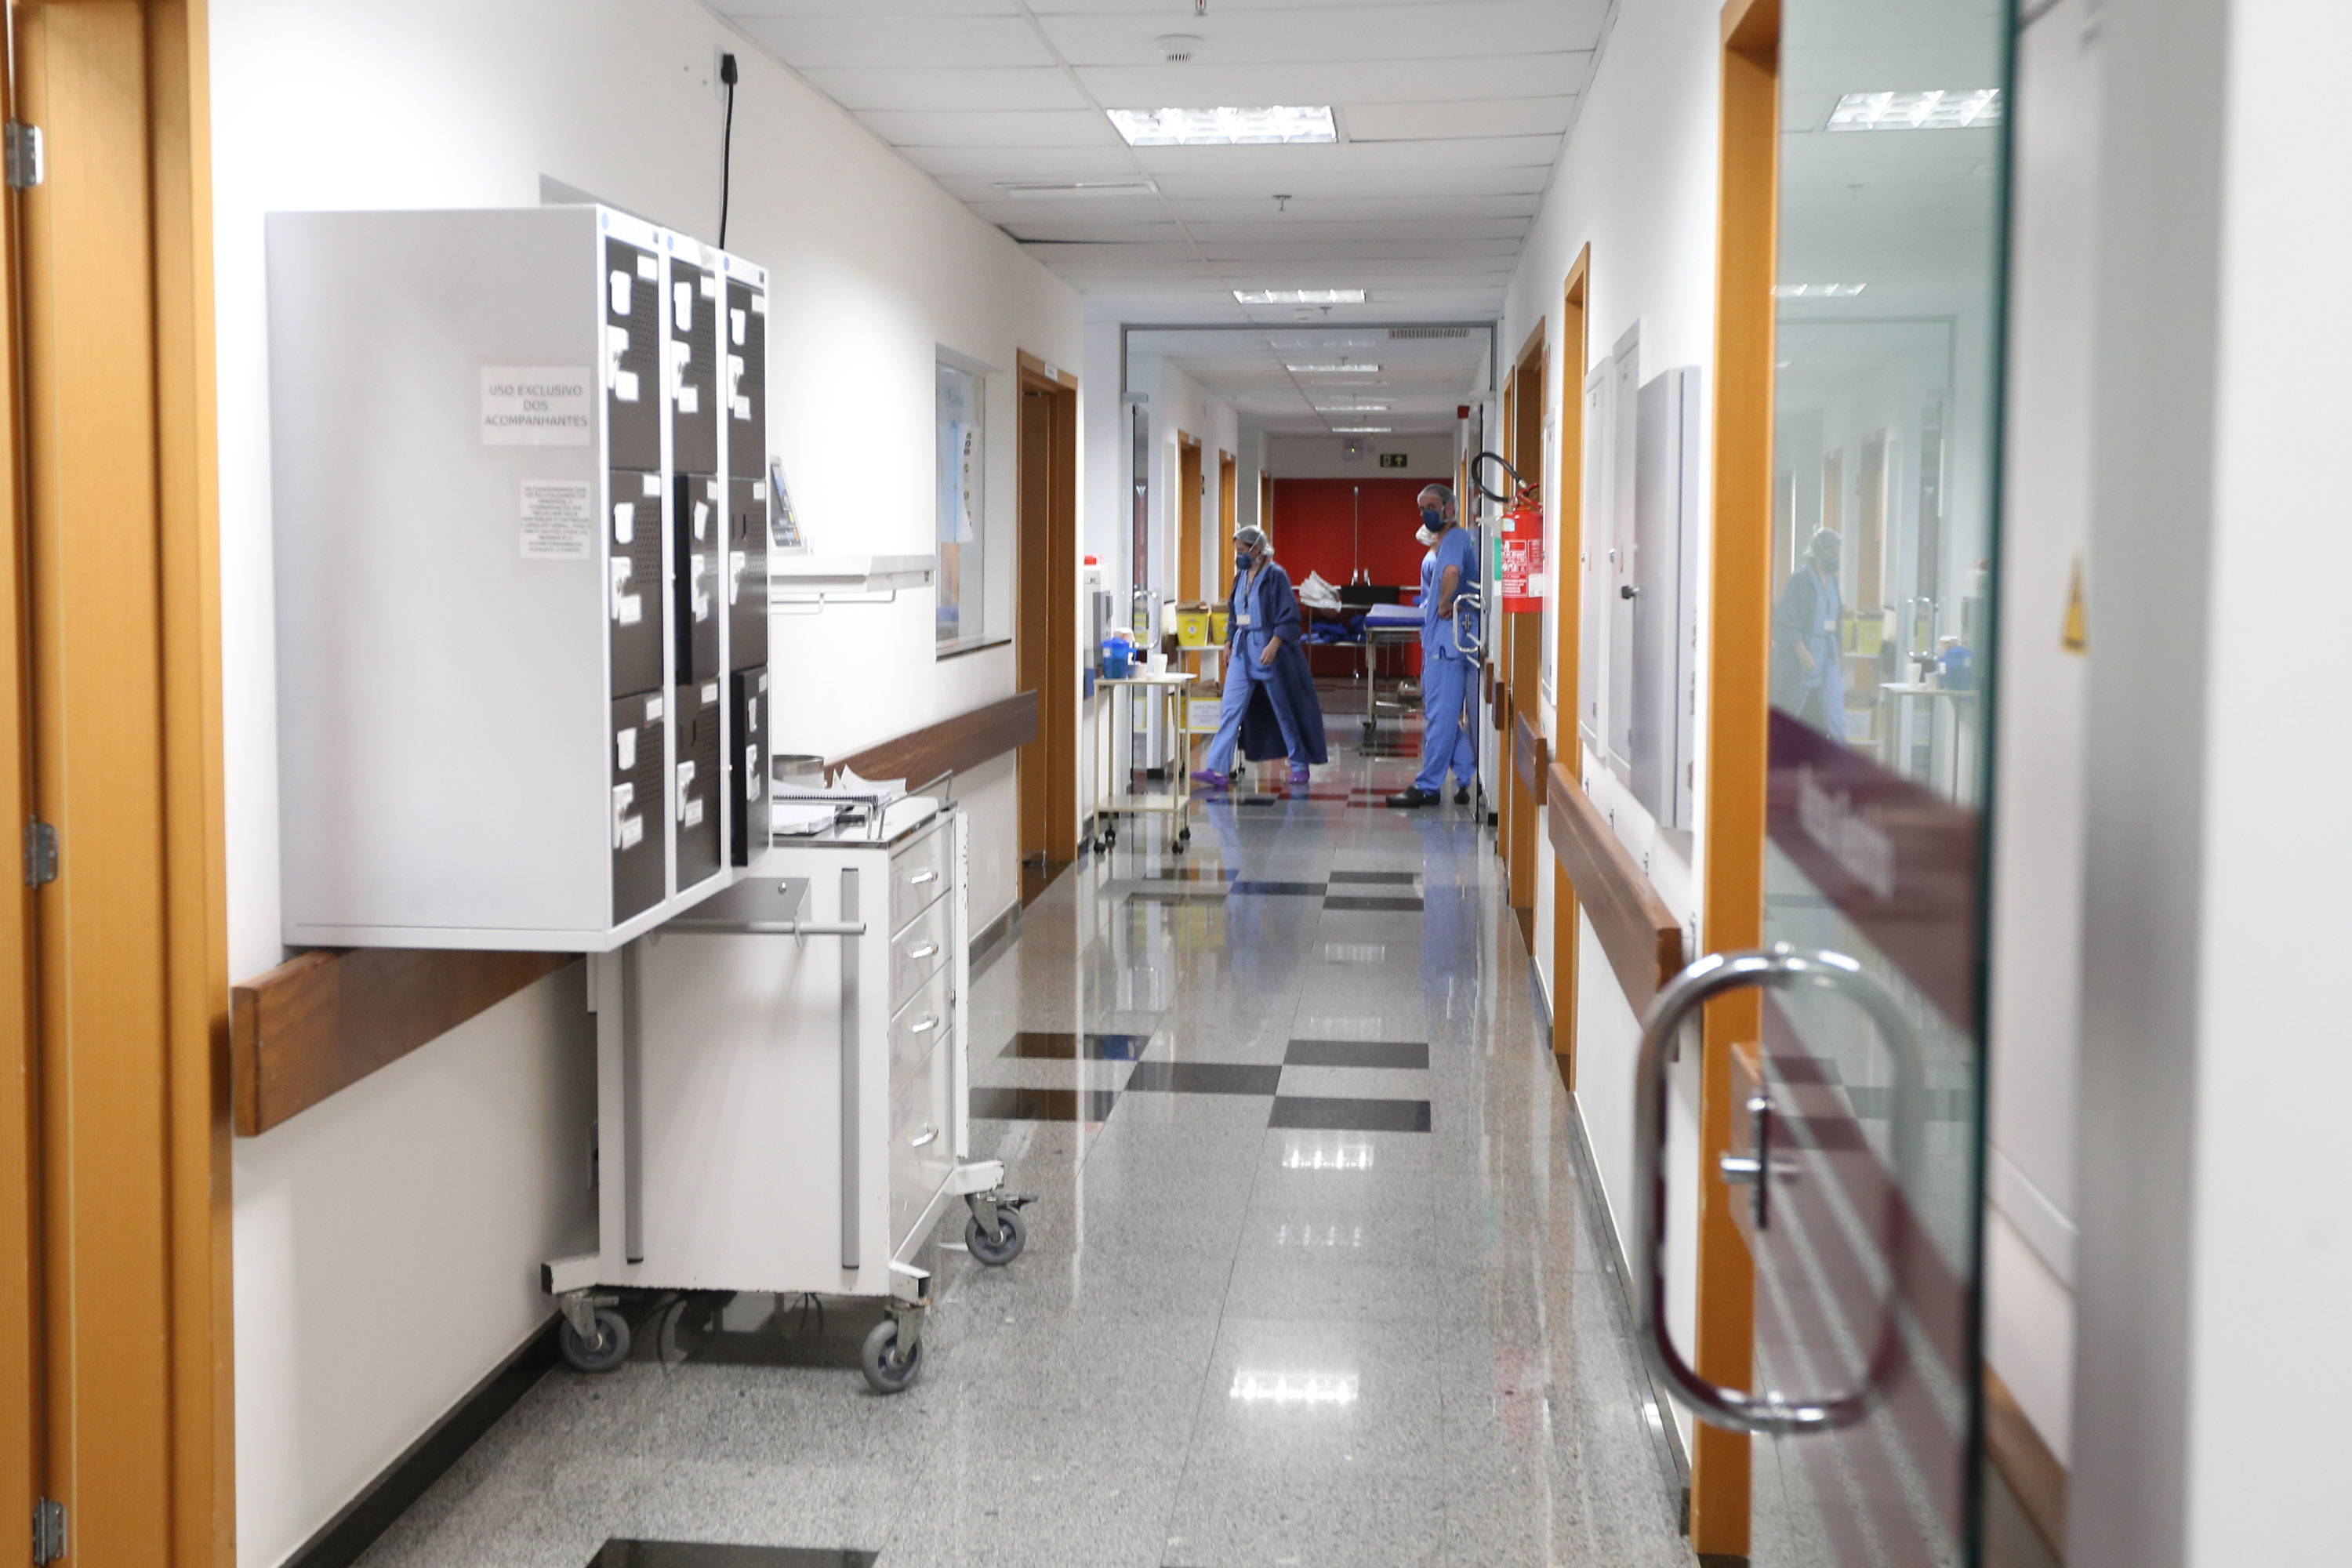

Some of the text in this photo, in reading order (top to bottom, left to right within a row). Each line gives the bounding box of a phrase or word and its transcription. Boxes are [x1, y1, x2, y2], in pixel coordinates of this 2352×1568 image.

[489, 385, 583, 396] USO EXCLUSIVO
[524, 401, 548, 412] DOS
[484, 415, 588, 427] ACOMPANHANTES
